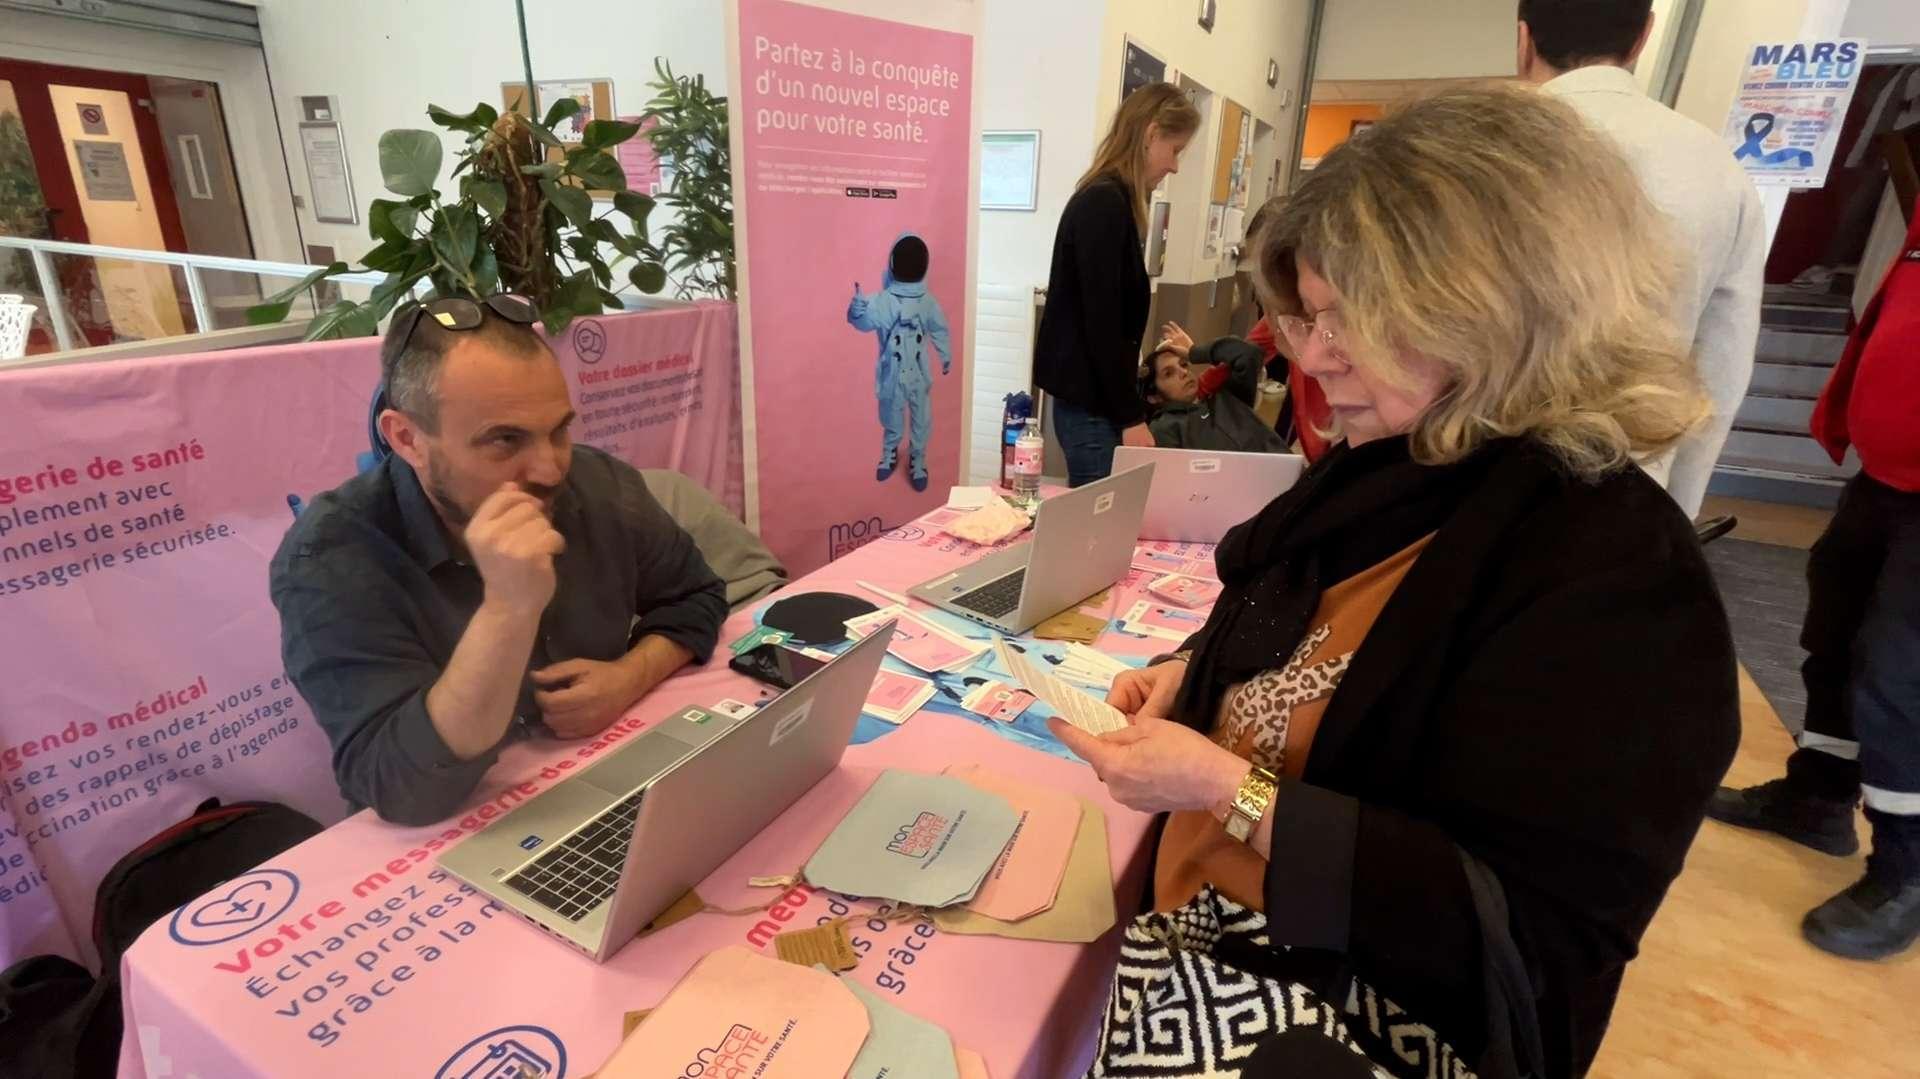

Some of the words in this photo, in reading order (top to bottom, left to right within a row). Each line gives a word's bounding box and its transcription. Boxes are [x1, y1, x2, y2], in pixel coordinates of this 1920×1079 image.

[755, 35, 824, 71] Partez
[831, 48, 842, 73] à
[850, 50, 865, 76] la
[872, 60, 960, 90] conquête
[1751, 42, 1858, 66] MARS
[1775, 61, 1855, 80] BLEU
[756, 70, 805, 99] d'un
[812, 83, 880, 109] nouvel
[886, 92, 951, 118] espace
[757, 108, 808, 135] pour
[814, 112, 867, 137] votre
[872, 120, 929, 144] santé.
[578, 370, 610, 385] Votre
[612, 361, 653, 379] dossier
[86, 456, 125, 481] de
[134, 438, 206, 474] santé
[116, 480, 174, 506] avec
[3, 530, 77, 563] nnels
[84, 522, 115, 543] de
[123, 503, 186, 534] santé
[123, 522, 237, 564] sécurisée.
[829, 515, 883, 543] mon
[0, 720, 98, 773] genda
[107, 675, 209, 731] médical
[69, 743, 116, 770] vos
[126, 680, 264, 750] rendez-vous
[25, 788, 71, 816] des
[79, 752, 169, 794] rappels
[176, 739, 202, 760] de
[209, 694, 295, 745] dépistage
[144, 763, 207, 798] grâce
[211, 754, 224, 770] à
[228, 715, 300, 763] l'agenda
[214, 900, 347, 975] Votre
[352, 782, 540, 898] messagerie
[540, 757, 578, 780] de
[576, 716, 647, 759] santé
[885, 823, 915, 852] mon
[245, 882, 426, 999] Échangez
[875, 922, 936, 995] grâce
[275, 970, 350, 1020] vos
[306, 964, 417, 1048] grâce
[416, 944, 442, 962] à
[437, 920, 477, 943] la
[764, 1041, 782, 1062] VOTRE
